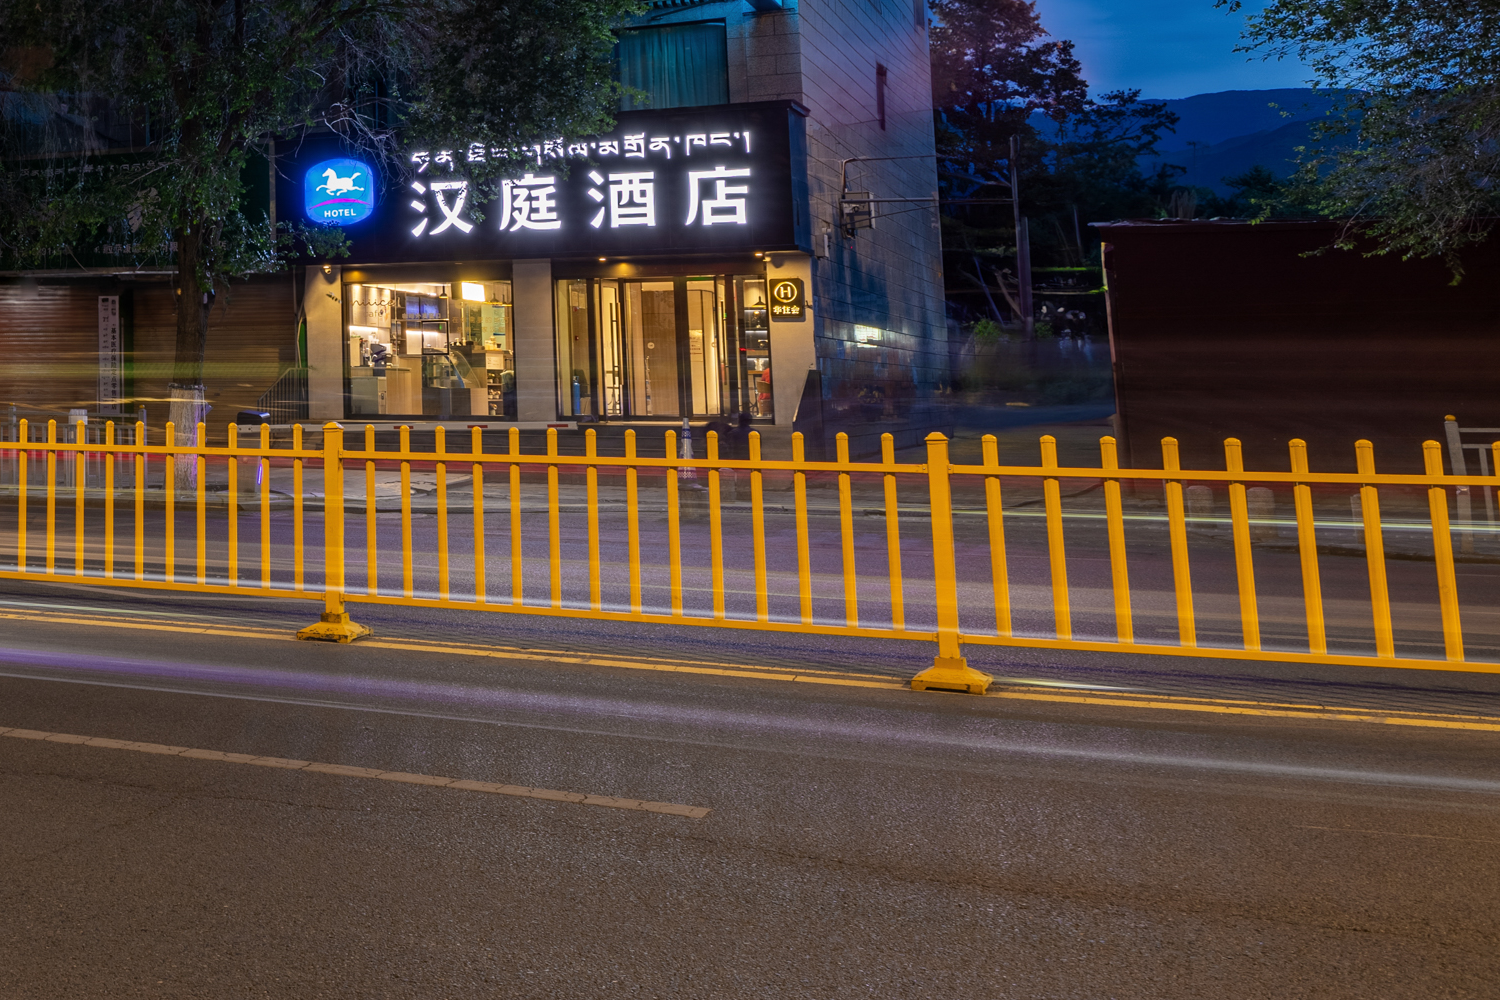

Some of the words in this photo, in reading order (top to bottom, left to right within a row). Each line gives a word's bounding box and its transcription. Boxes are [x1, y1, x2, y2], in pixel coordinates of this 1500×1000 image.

[410, 165, 752, 238] 汉庭酒店
[323, 208, 357, 218] HOTEL
[772, 304, 801, 315] 华住会
